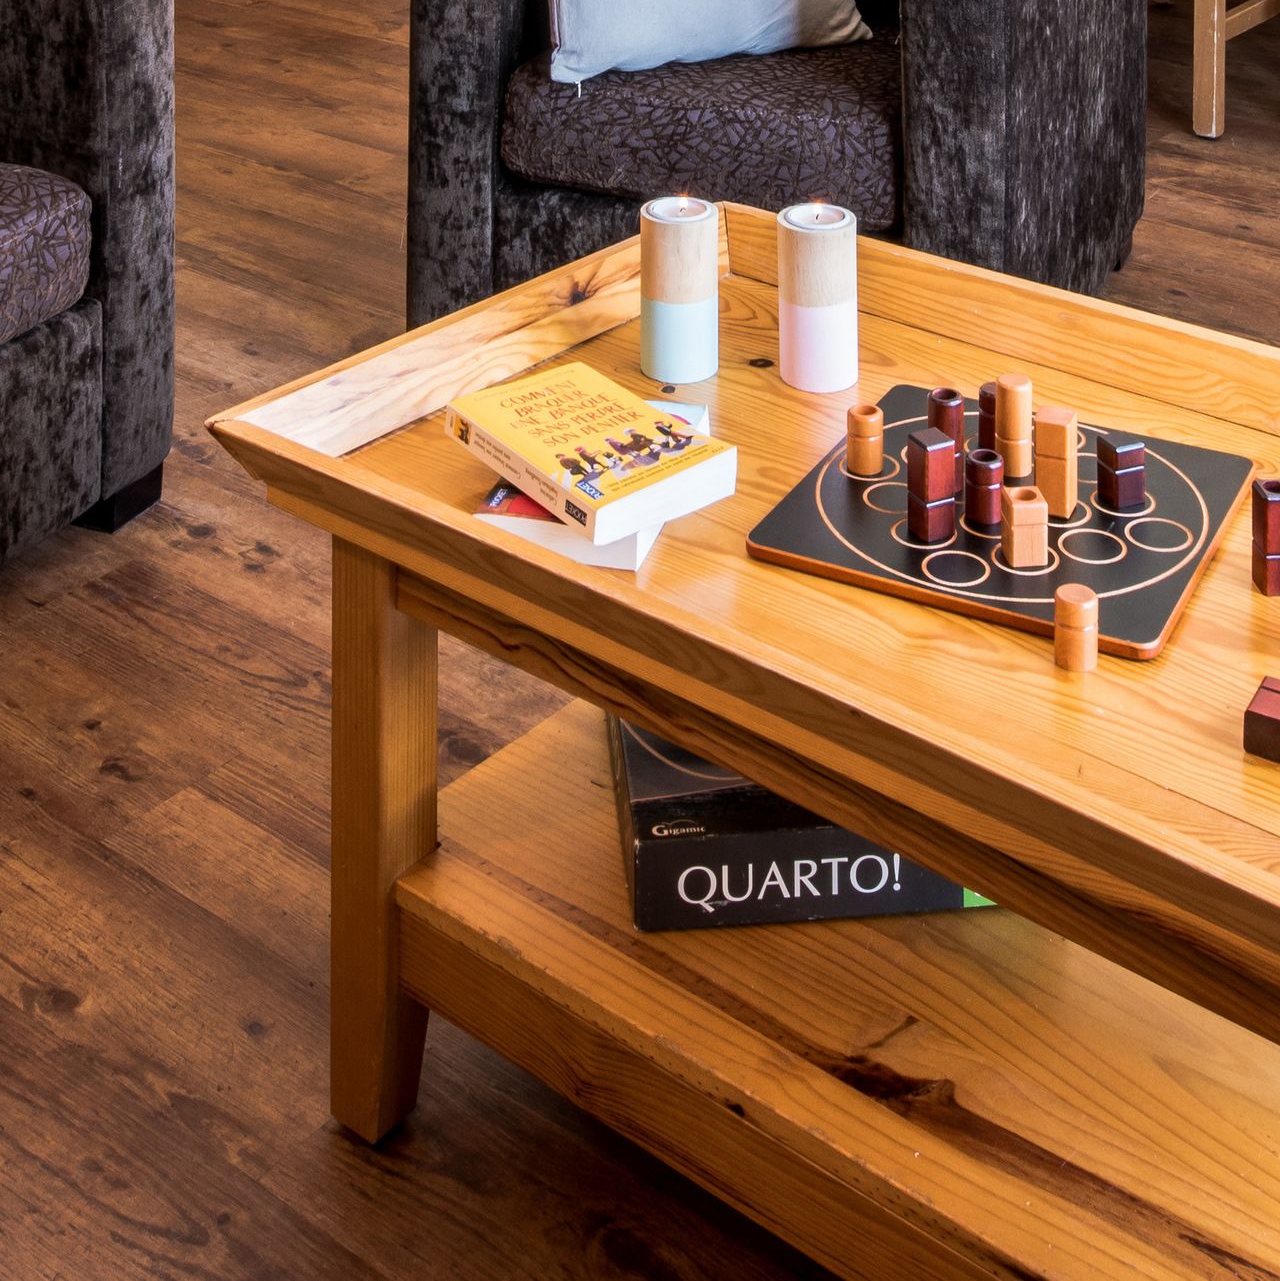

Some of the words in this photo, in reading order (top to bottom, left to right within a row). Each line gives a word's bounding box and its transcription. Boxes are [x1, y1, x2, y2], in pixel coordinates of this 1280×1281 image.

[500, 380, 577, 409] COMMENT
[509, 416, 548, 430] UNE
[548, 392, 618, 421] BANQUE
[514, 390, 590, 418] BRAQUER
[528, 422, 570, 439] SANS
[570, 401, 634, 425] PERDRE
[542, 432, 581, 448] SON
[579, 410, 645, 436] DENTIER
[566, 501, 587, 526] POCKET
[651, 824, 706, 837] Gigamic
[677, 853, 901, 913] QUARTO!
